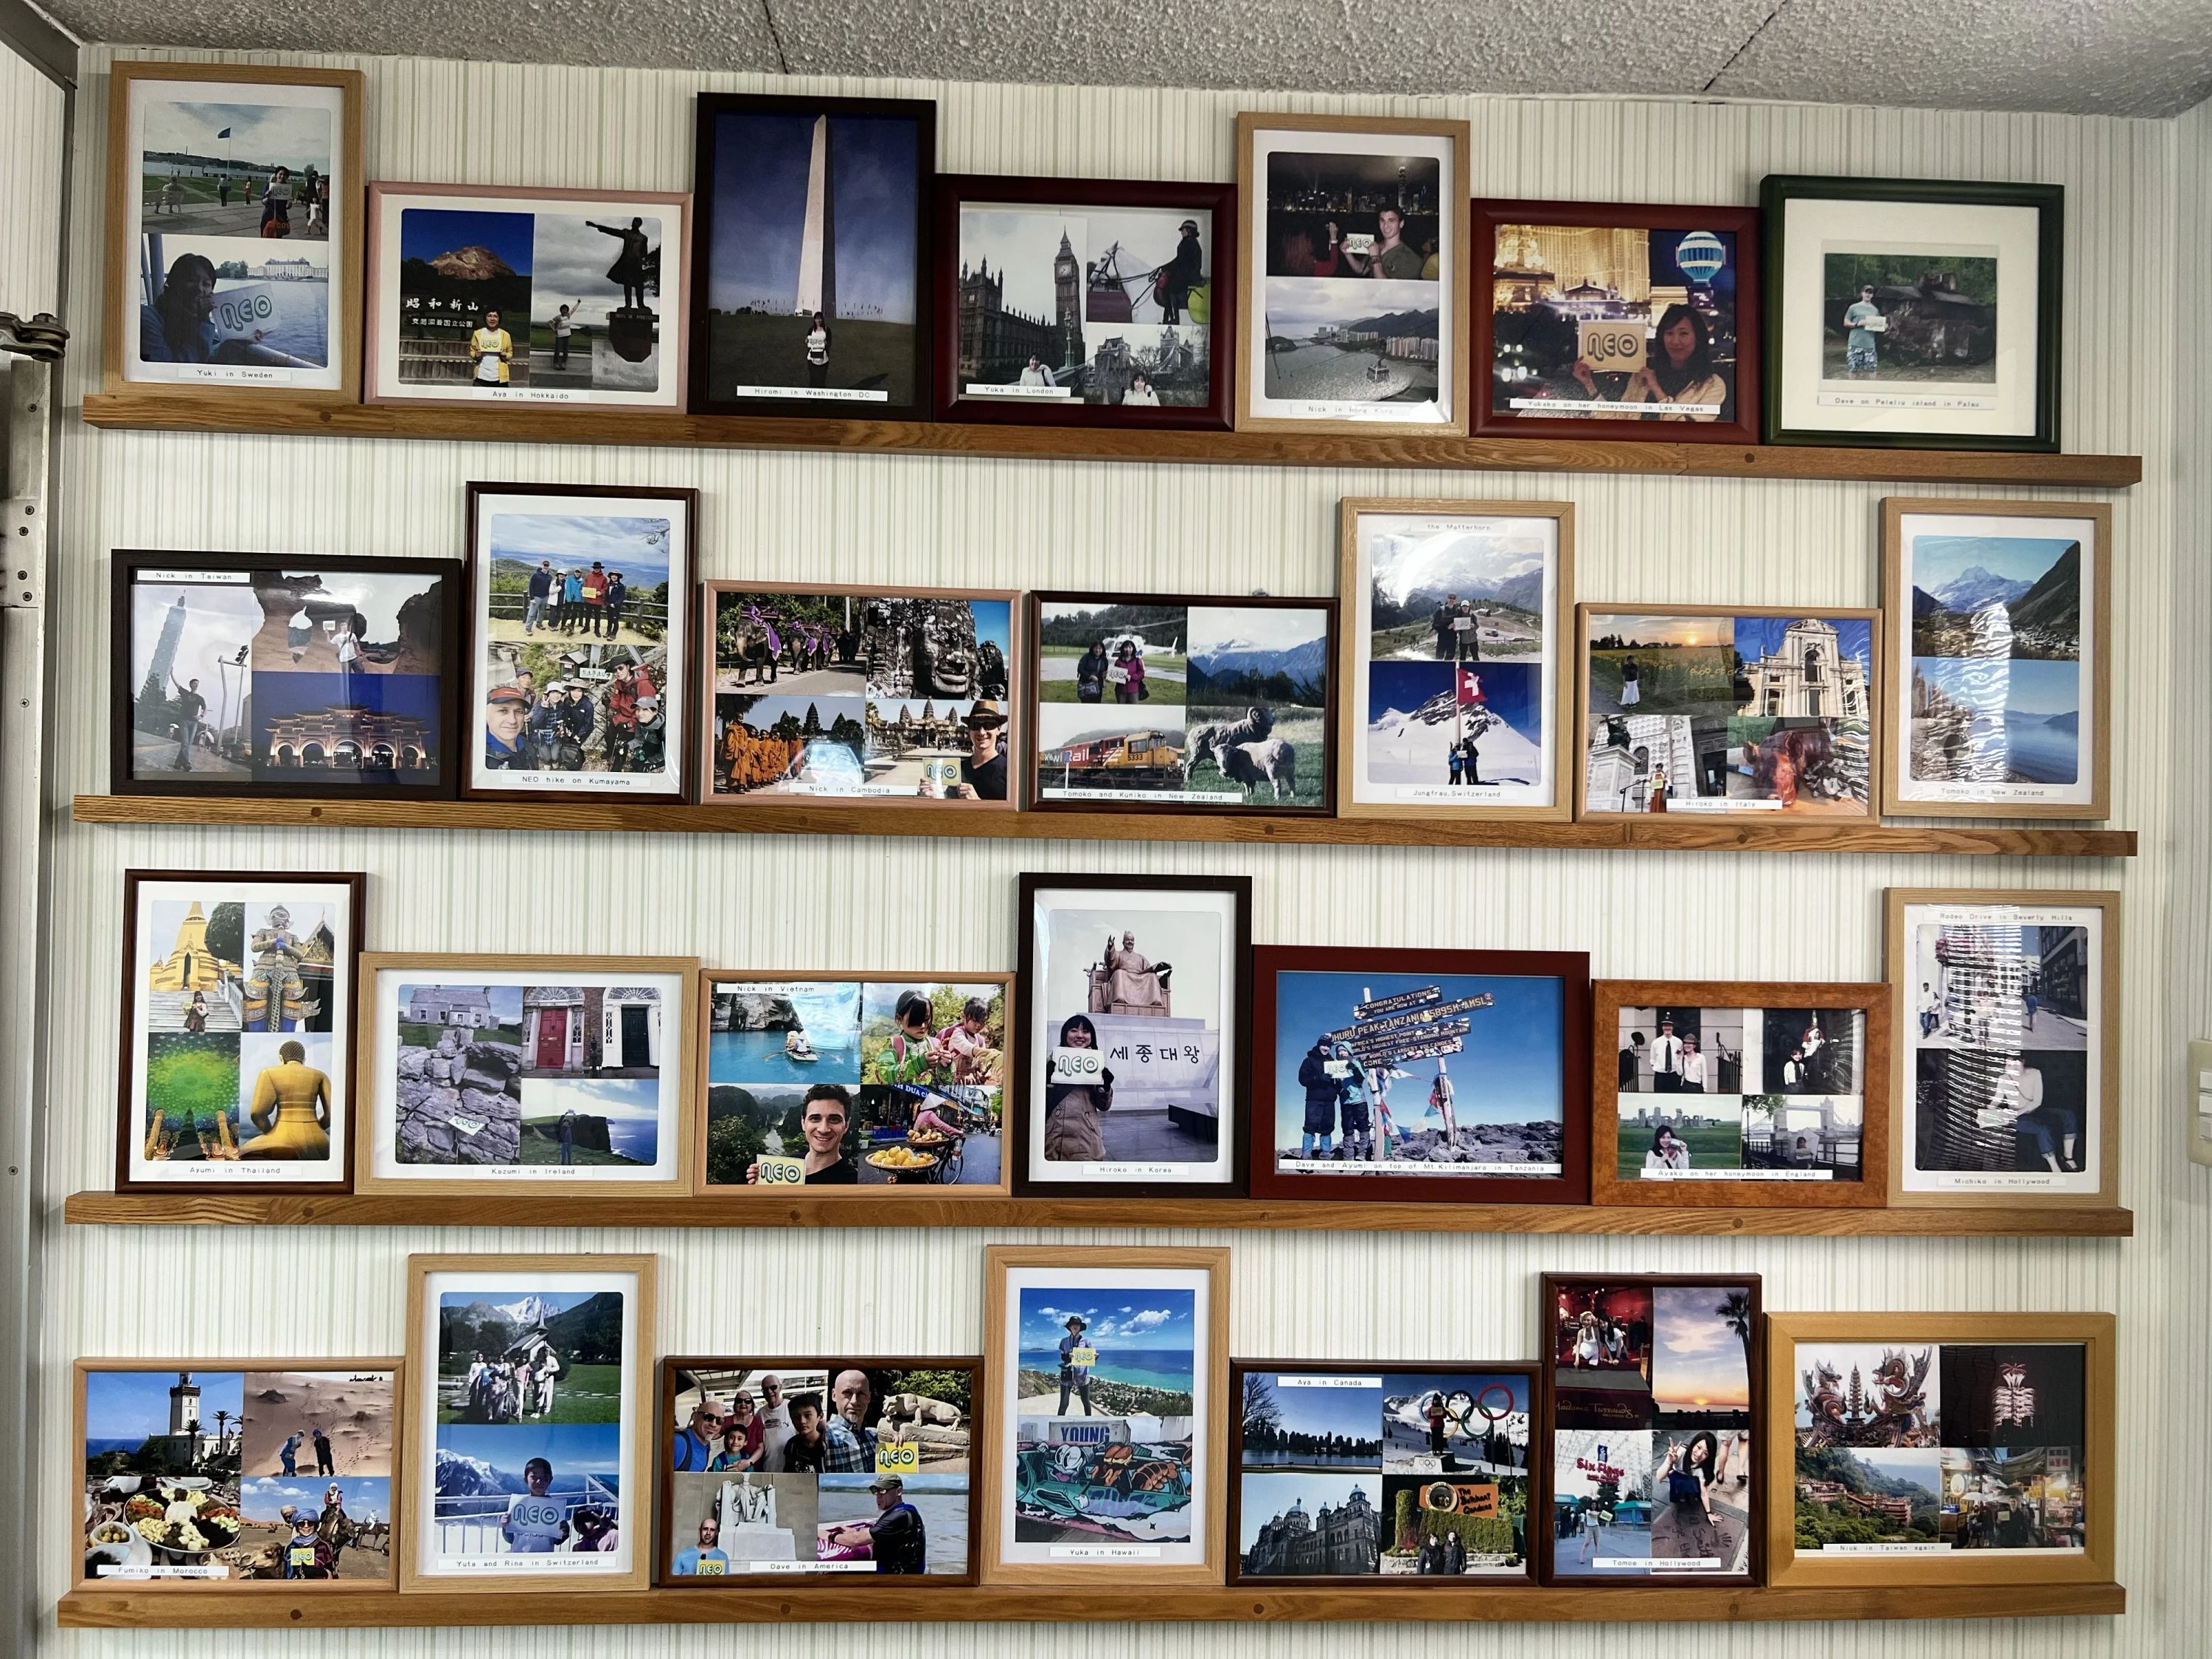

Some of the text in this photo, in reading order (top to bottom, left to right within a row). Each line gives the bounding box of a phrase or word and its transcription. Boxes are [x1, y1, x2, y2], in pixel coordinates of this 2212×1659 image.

[405, 298, 479, 311] 昭和新山
[530, 392, 569, 400] Hokkaido
[805, 389, 852, 397] Washington
[201, 572, 232, 580] Taiwan
[927, 764, 956, 779] NO
[851, 786, 890, 794] Cambodia
[2013, 914, 2045, 922] Beverly
[1464, 997, 1487, 1009] AMSL
[1576, 1458, 1596, 1472] Six
[118, 1566, 149, 1574] Fumiko
